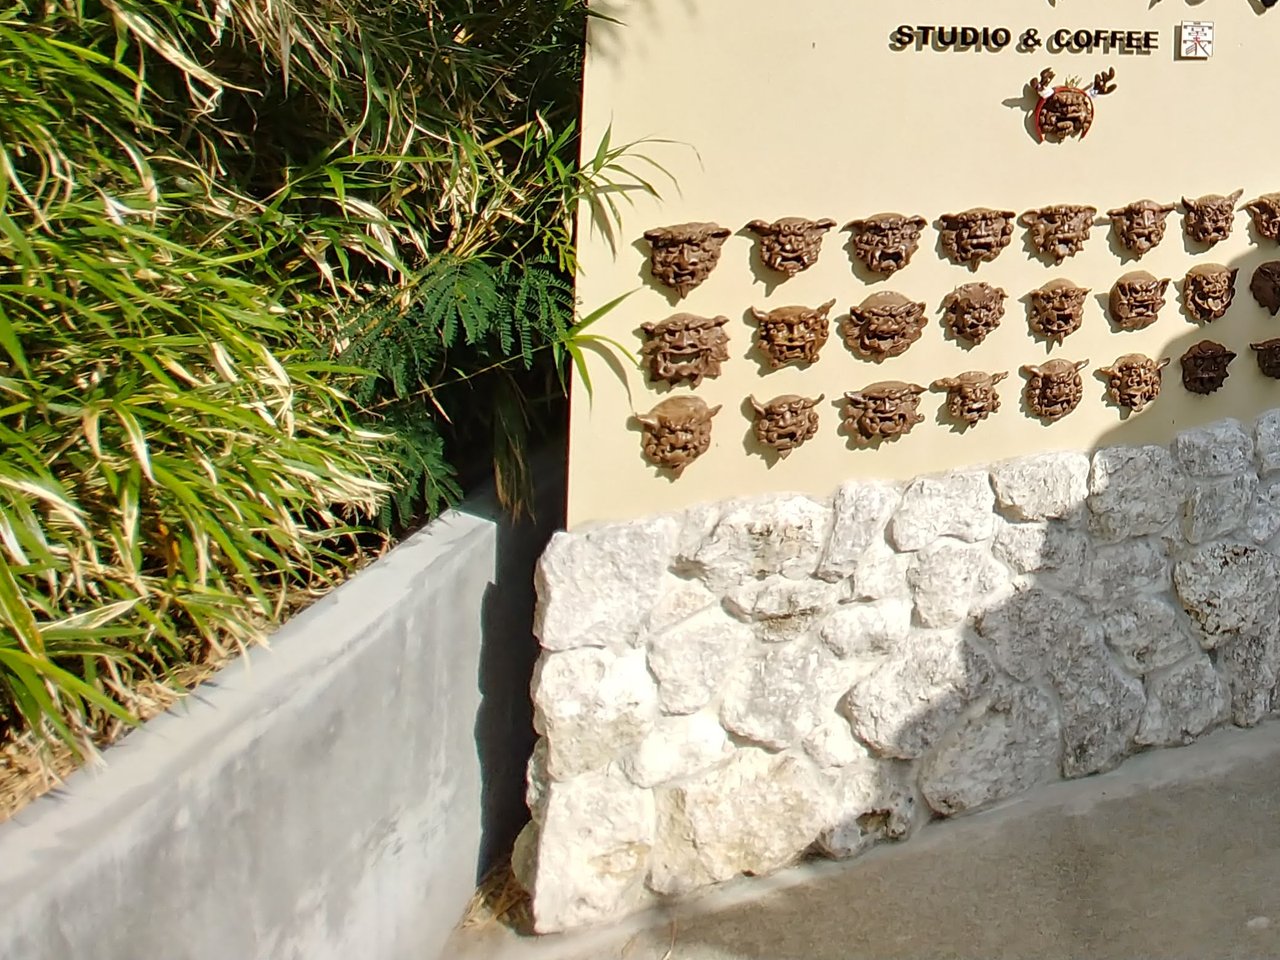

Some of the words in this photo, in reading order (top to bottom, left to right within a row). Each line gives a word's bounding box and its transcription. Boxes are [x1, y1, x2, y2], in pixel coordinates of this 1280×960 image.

[895, 25, 1012, 47] STUDIO
[1022, 28, 1042, 48] &
[1053, 28, 1159, 49] COFFEE
